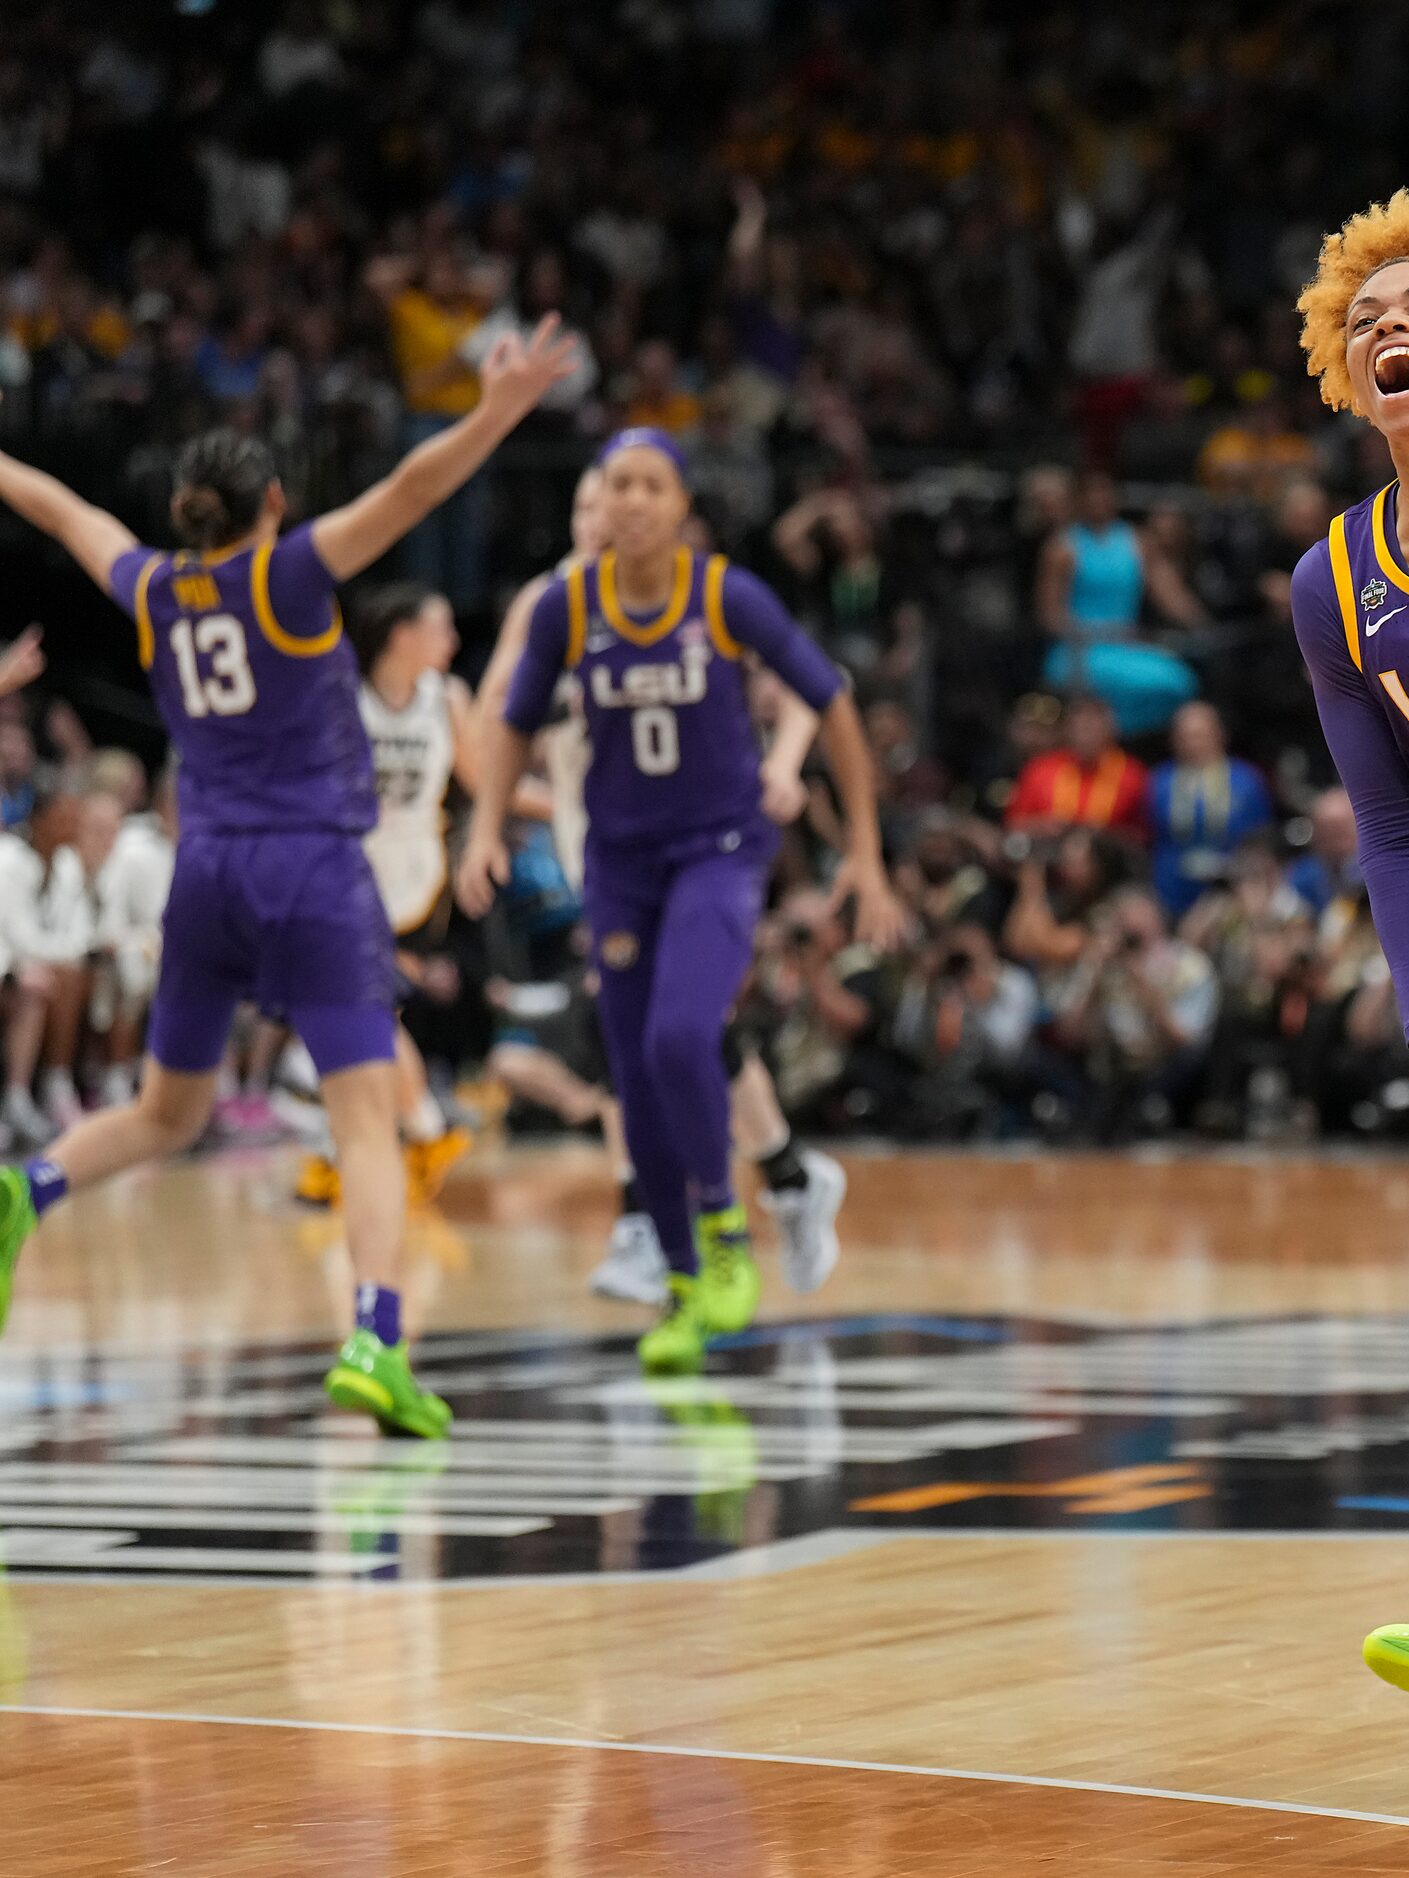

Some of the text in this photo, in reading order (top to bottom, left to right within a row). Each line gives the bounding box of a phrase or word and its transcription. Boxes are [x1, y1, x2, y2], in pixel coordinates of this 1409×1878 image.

[169, 613, 257, 718] 13
[589, 656, 708, 709] LSU
[632, 706, 680, 777] 0
